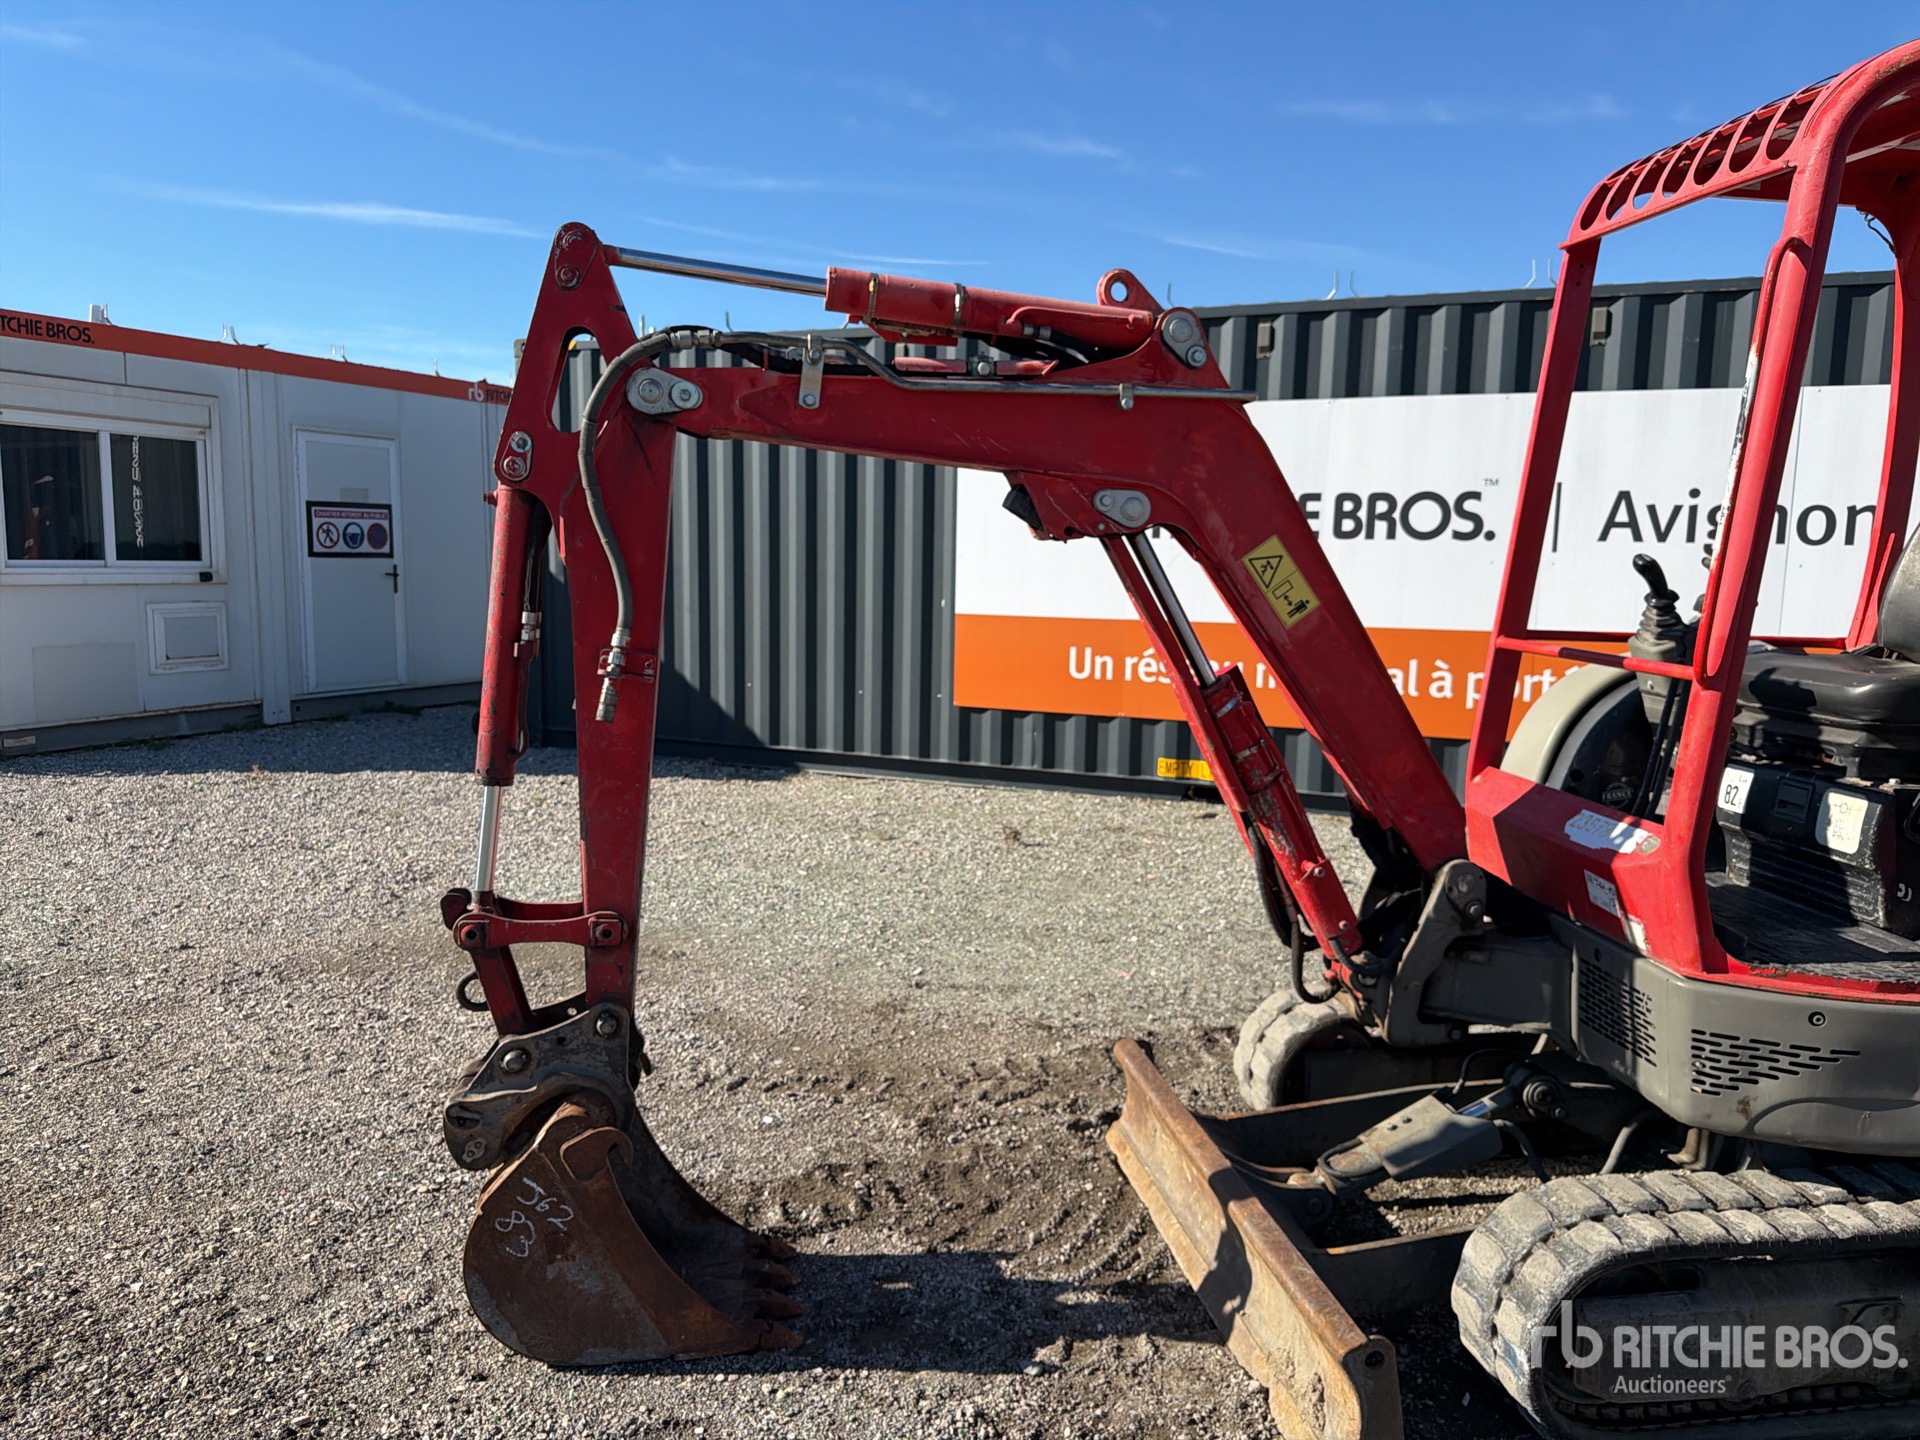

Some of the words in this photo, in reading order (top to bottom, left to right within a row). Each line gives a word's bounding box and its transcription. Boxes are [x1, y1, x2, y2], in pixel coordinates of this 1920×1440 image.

[46, 321, 96, 344] BROS.
[1333, 491, 1496, 541] BROS.
[1069, 646, 1114, 681] Un
[1428, 659, 1454, 699] à
[1724, 784, 1740, 806] 82
